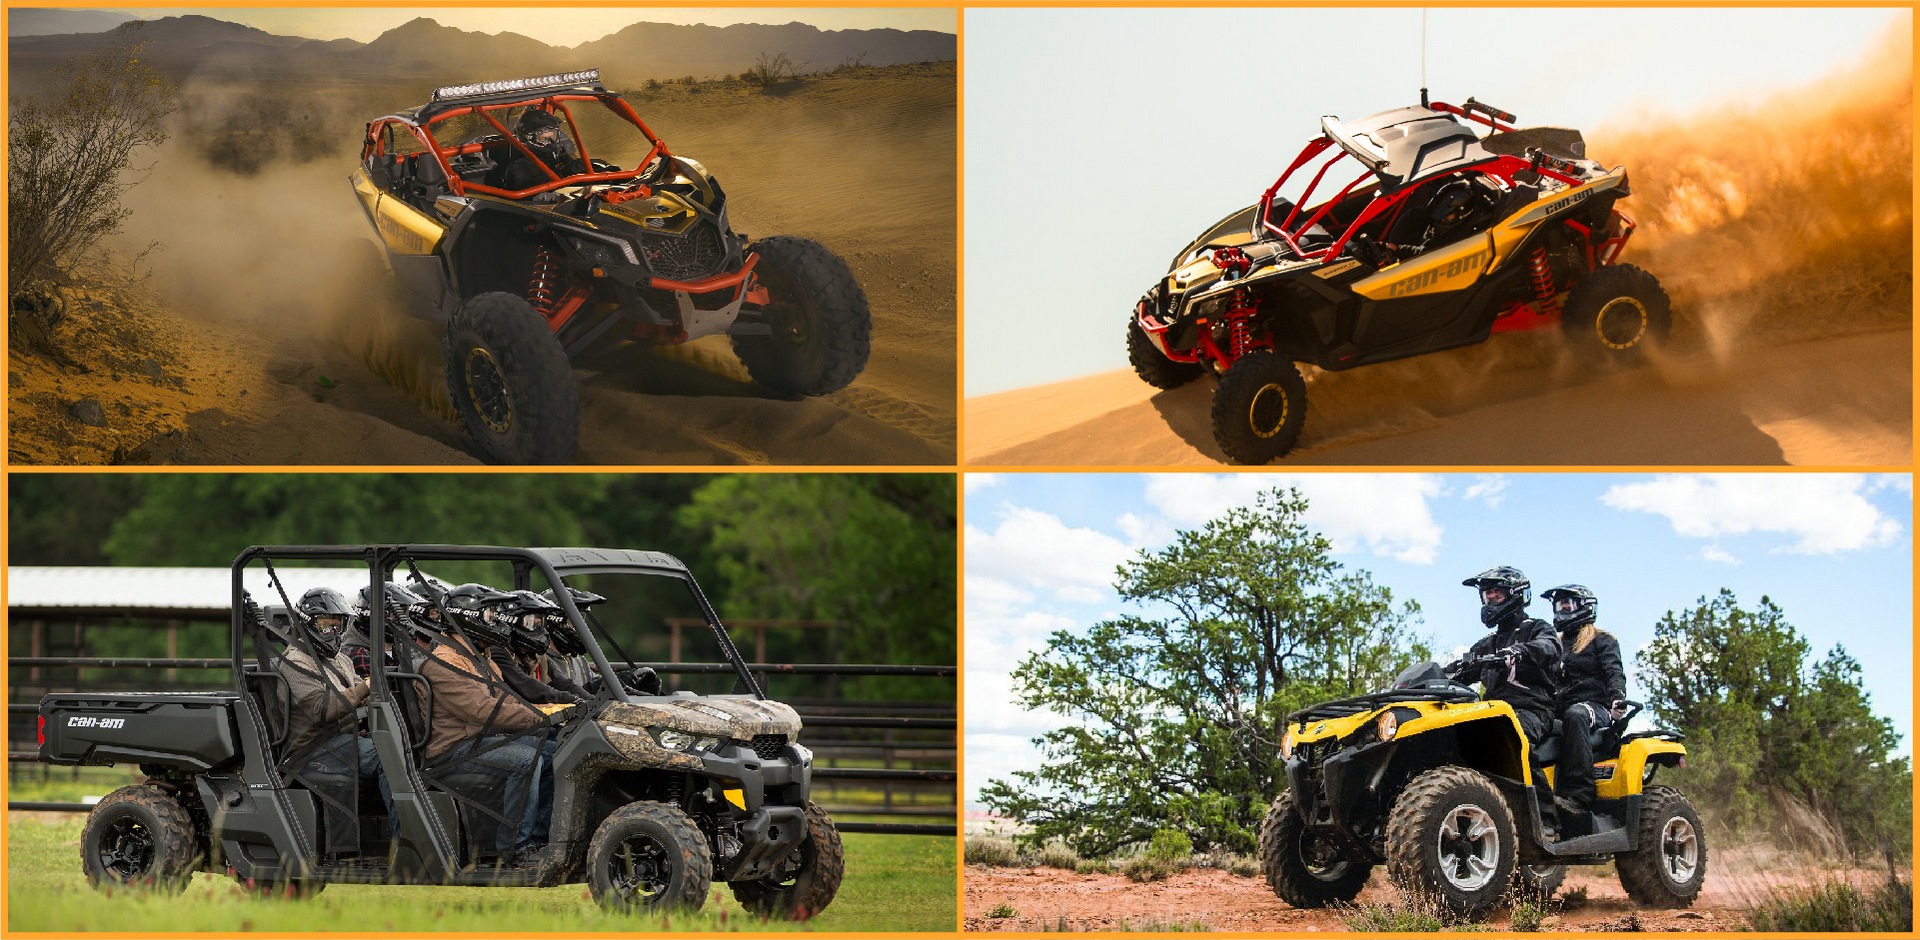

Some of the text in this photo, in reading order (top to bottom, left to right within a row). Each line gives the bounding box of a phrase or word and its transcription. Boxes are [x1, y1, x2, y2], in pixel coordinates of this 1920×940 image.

[1545, 187, 1594, 215] can-am
[1389, 249, 1487, 297] can-am
[67, 716, 126, 729] can-am
